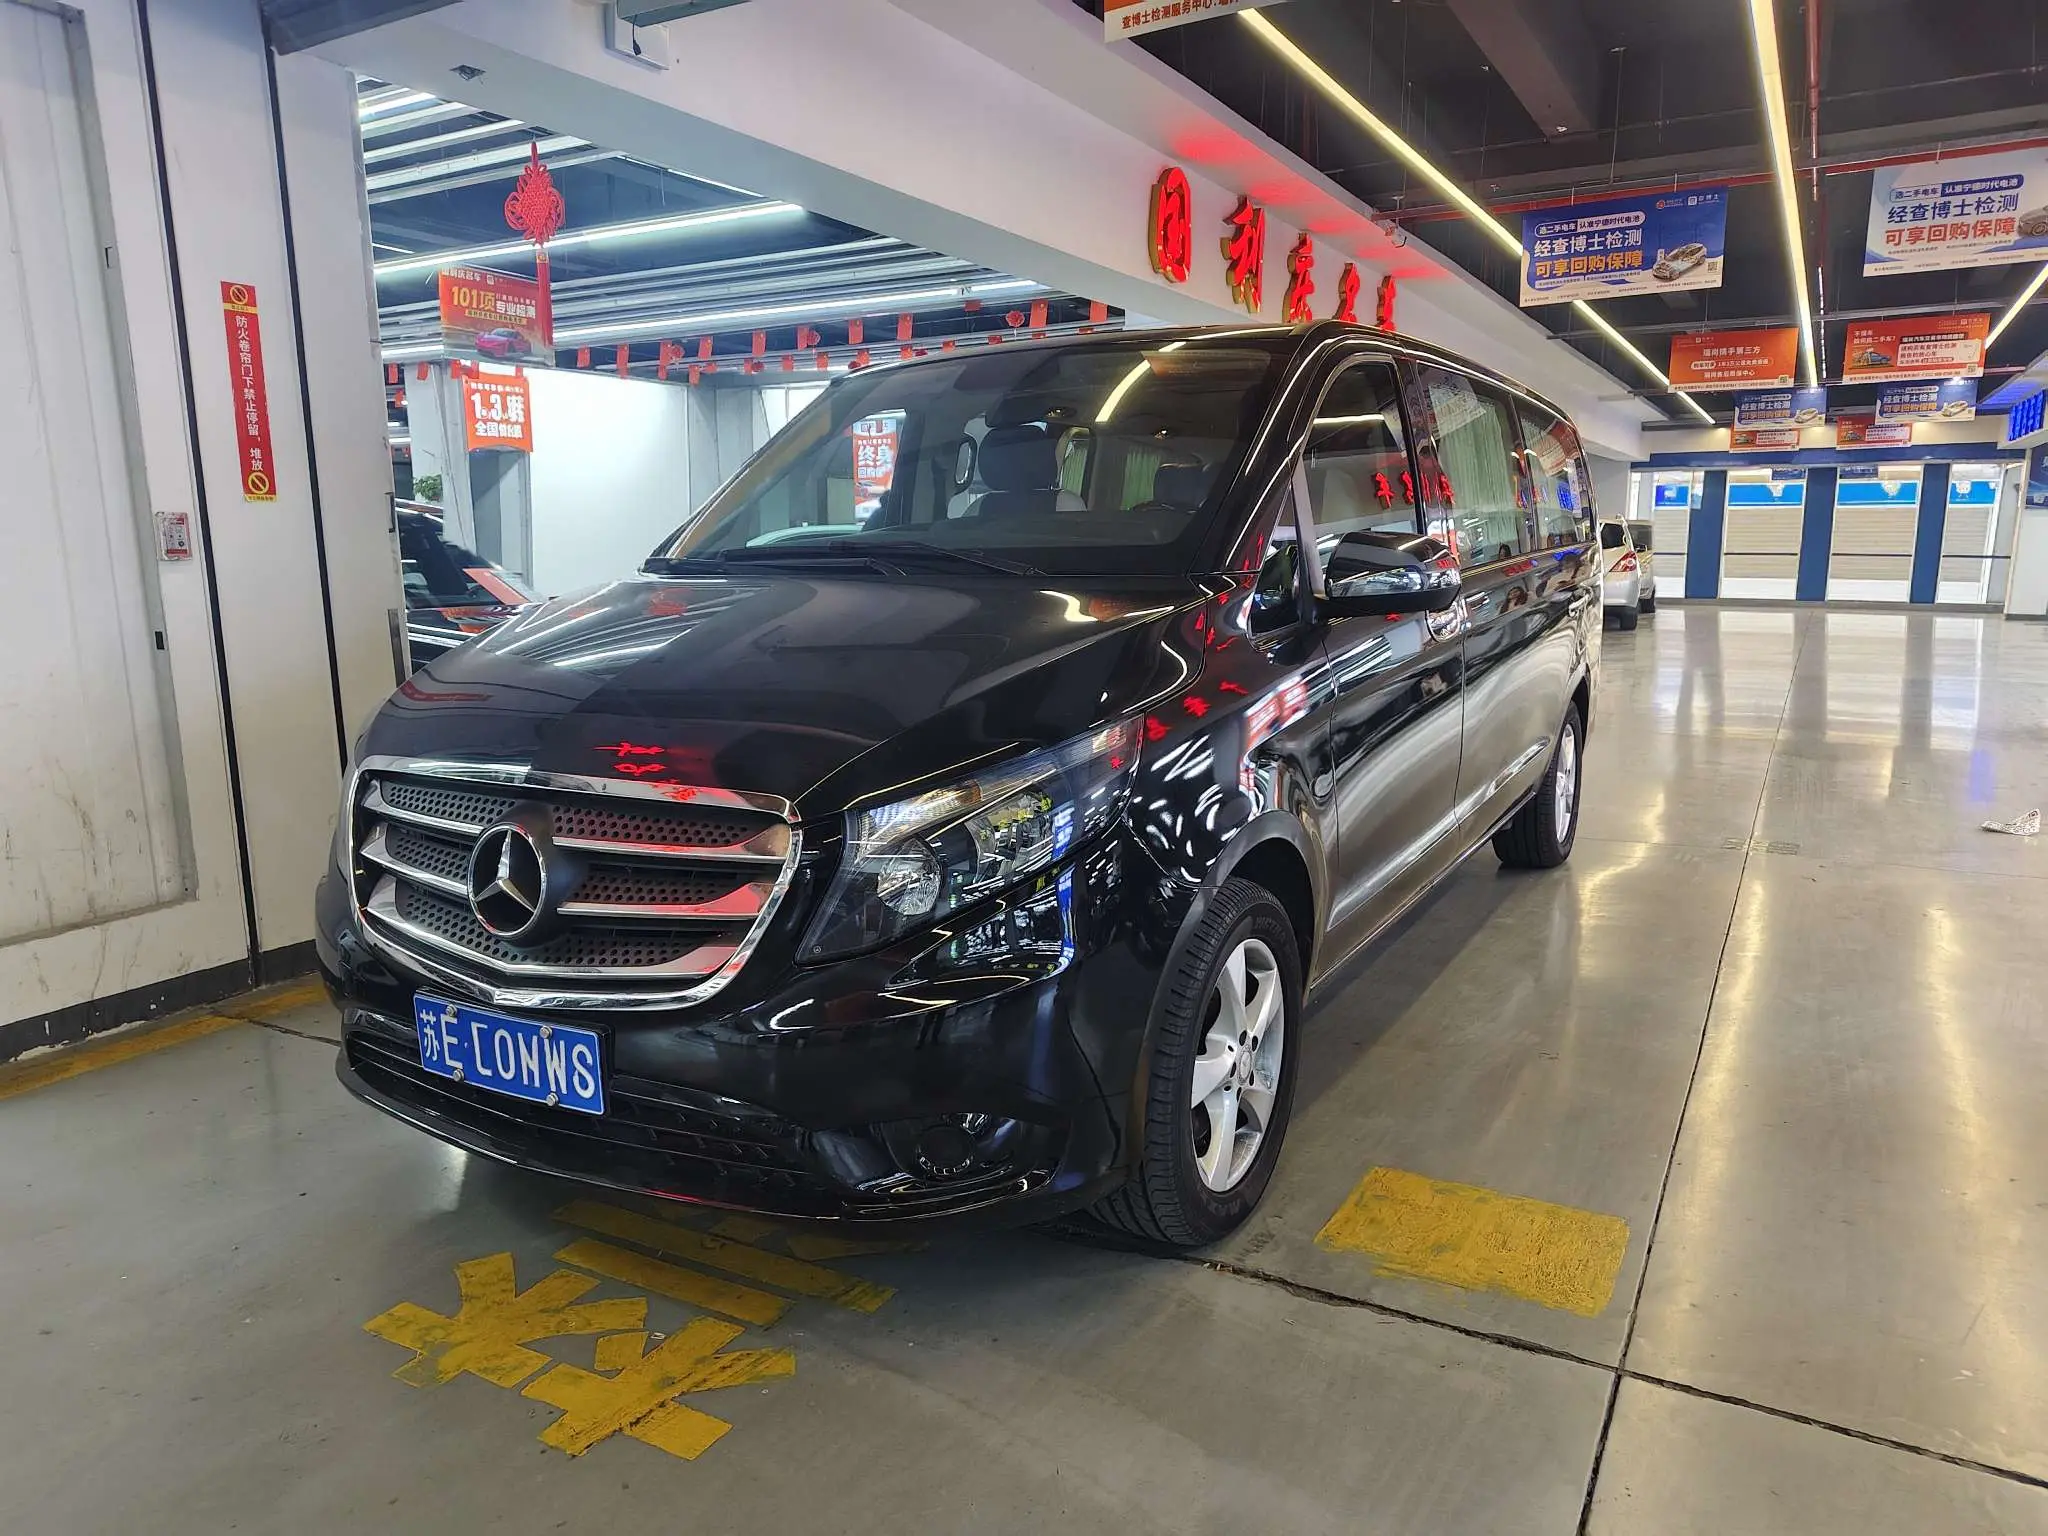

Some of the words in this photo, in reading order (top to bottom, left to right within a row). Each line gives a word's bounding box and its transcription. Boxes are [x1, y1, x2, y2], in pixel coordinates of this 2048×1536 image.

[1888, 192, 2019, 224] 经查博士检测
[1534, 228, 1642, 258] 经查博士检测
[1885, 217, 2017, 247] 可享回购保障
[1535, 250, 1643, 278] 可享回购保障
[451, 286, 495, 312] 101项
